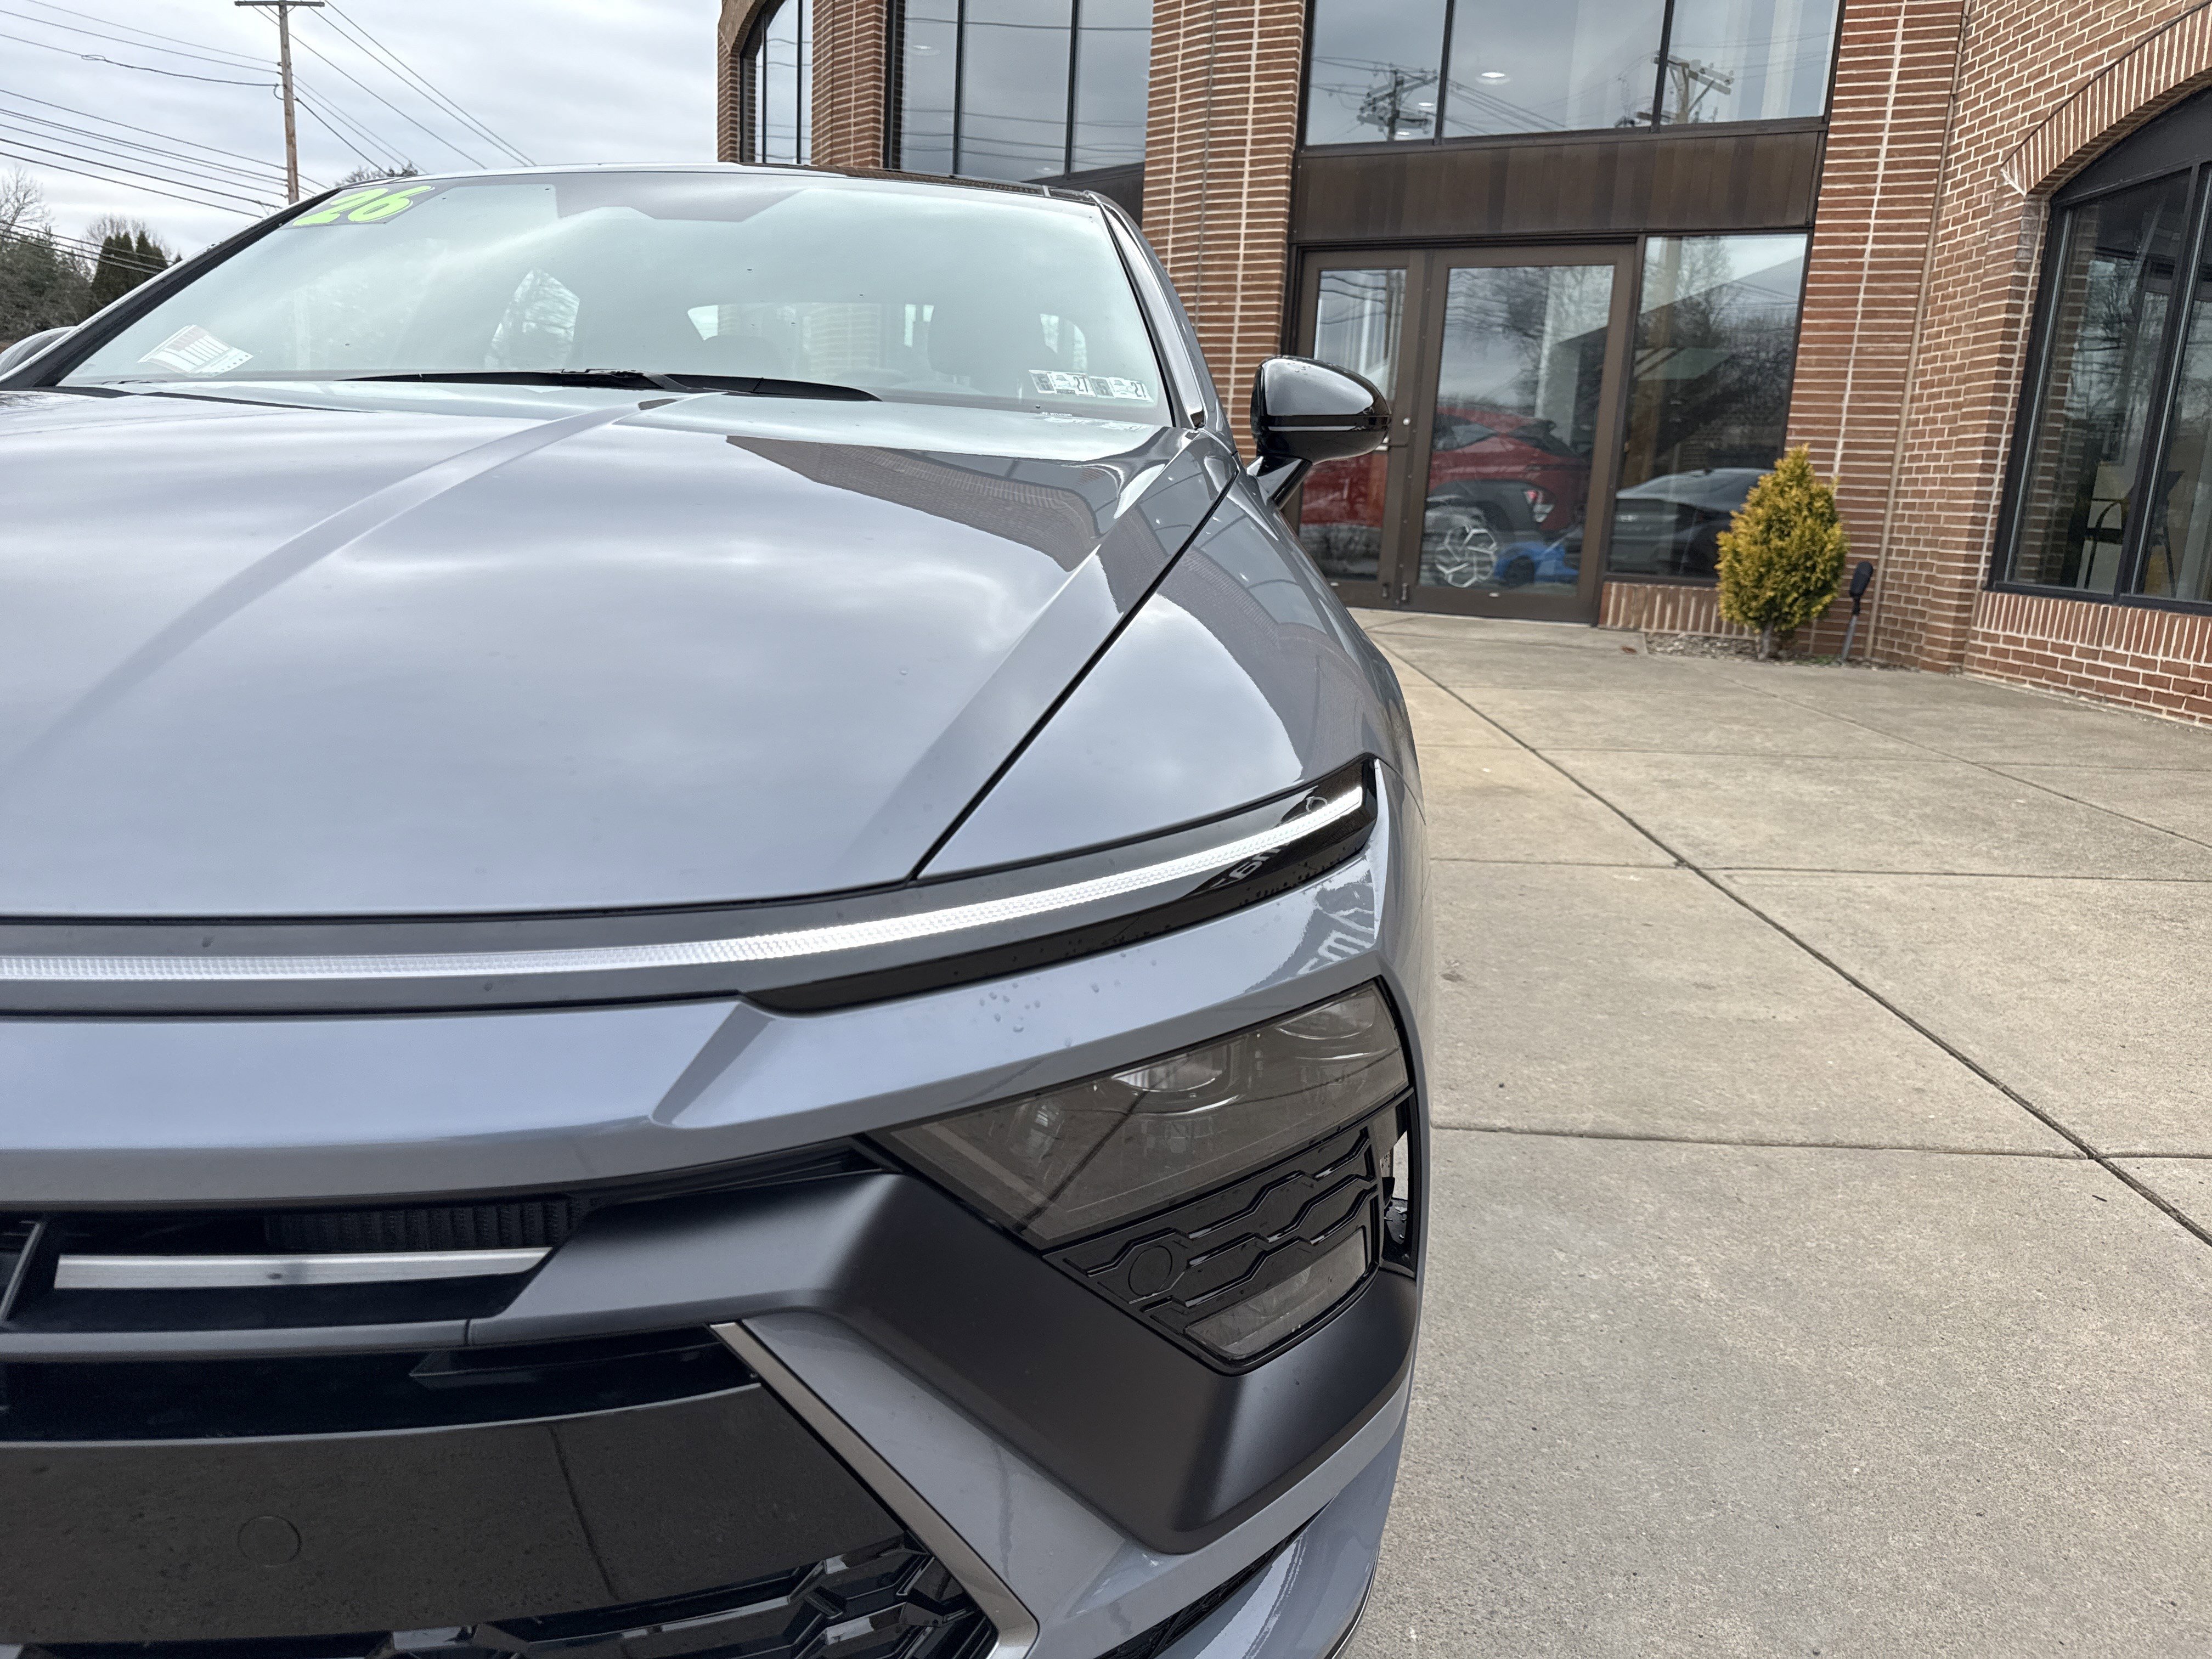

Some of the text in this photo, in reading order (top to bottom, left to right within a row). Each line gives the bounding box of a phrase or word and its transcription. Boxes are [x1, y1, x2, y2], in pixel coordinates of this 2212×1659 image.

[292, 185, 433, 226] 26
[1073, 375, 1088, 393] 27
[1130, 381, 1147, 398] 27
